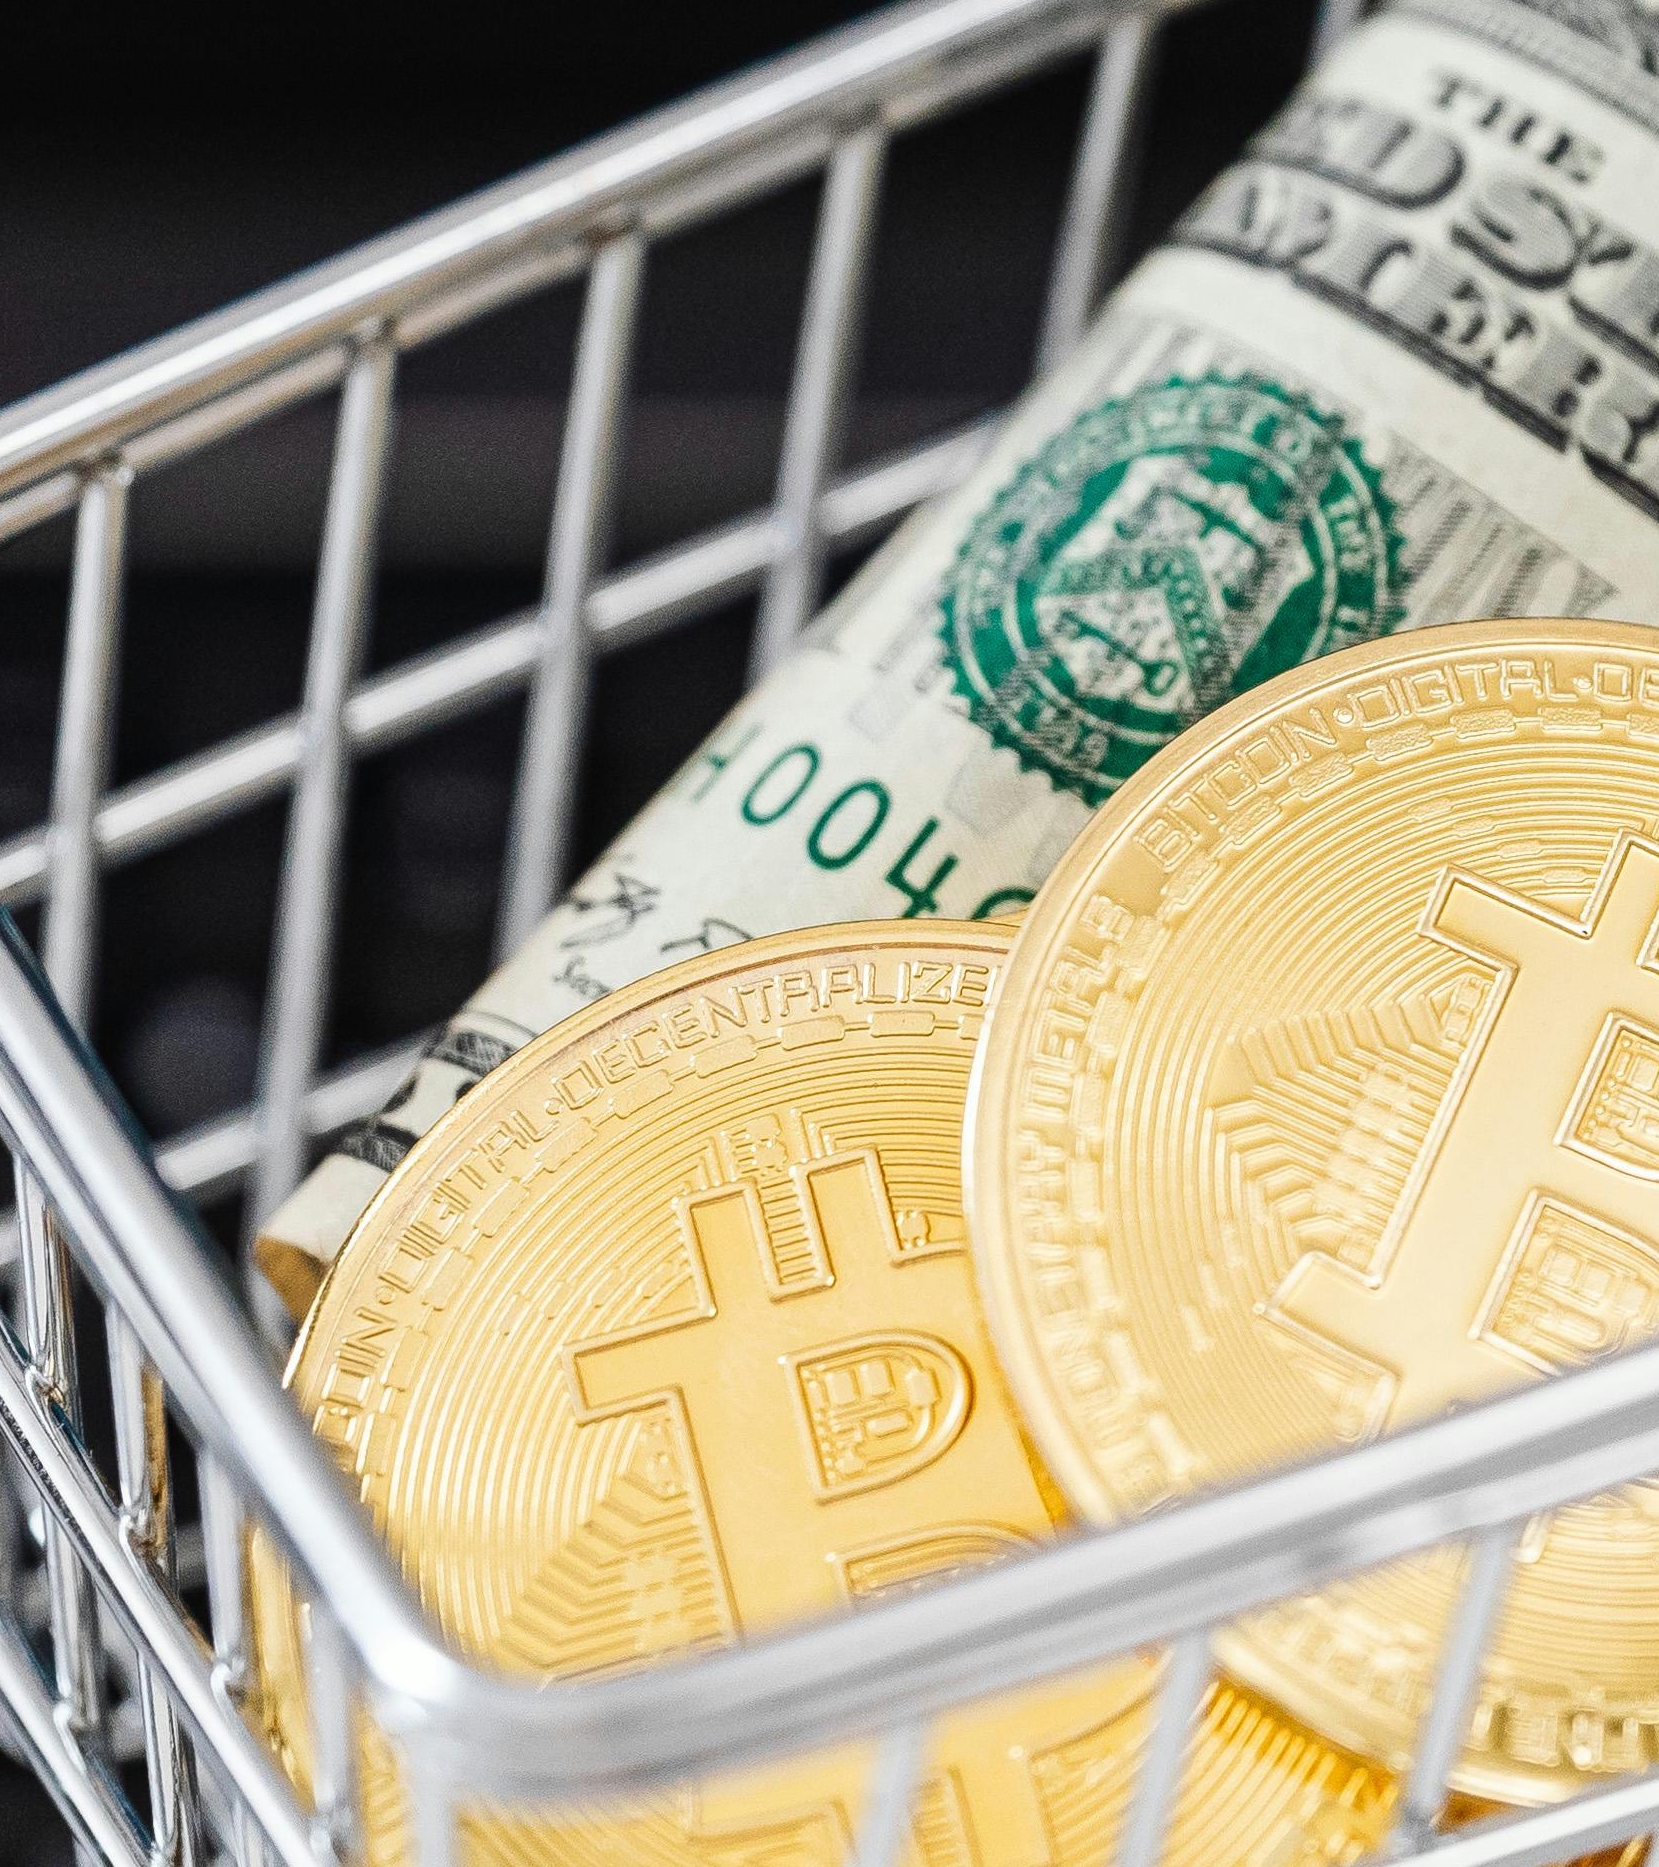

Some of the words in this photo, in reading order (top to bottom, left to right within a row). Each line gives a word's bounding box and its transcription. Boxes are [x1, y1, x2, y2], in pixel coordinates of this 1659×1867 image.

[1434, 72, 1606, 184] THE
[1133, 706, 1340, 875] BITCOIN
[1346, 658, 1580, 731] DIGITAL
[376, 1108, 562, 1296] DIGITAL
[550, 958, 1002, 1114] DECENTRALIZE
